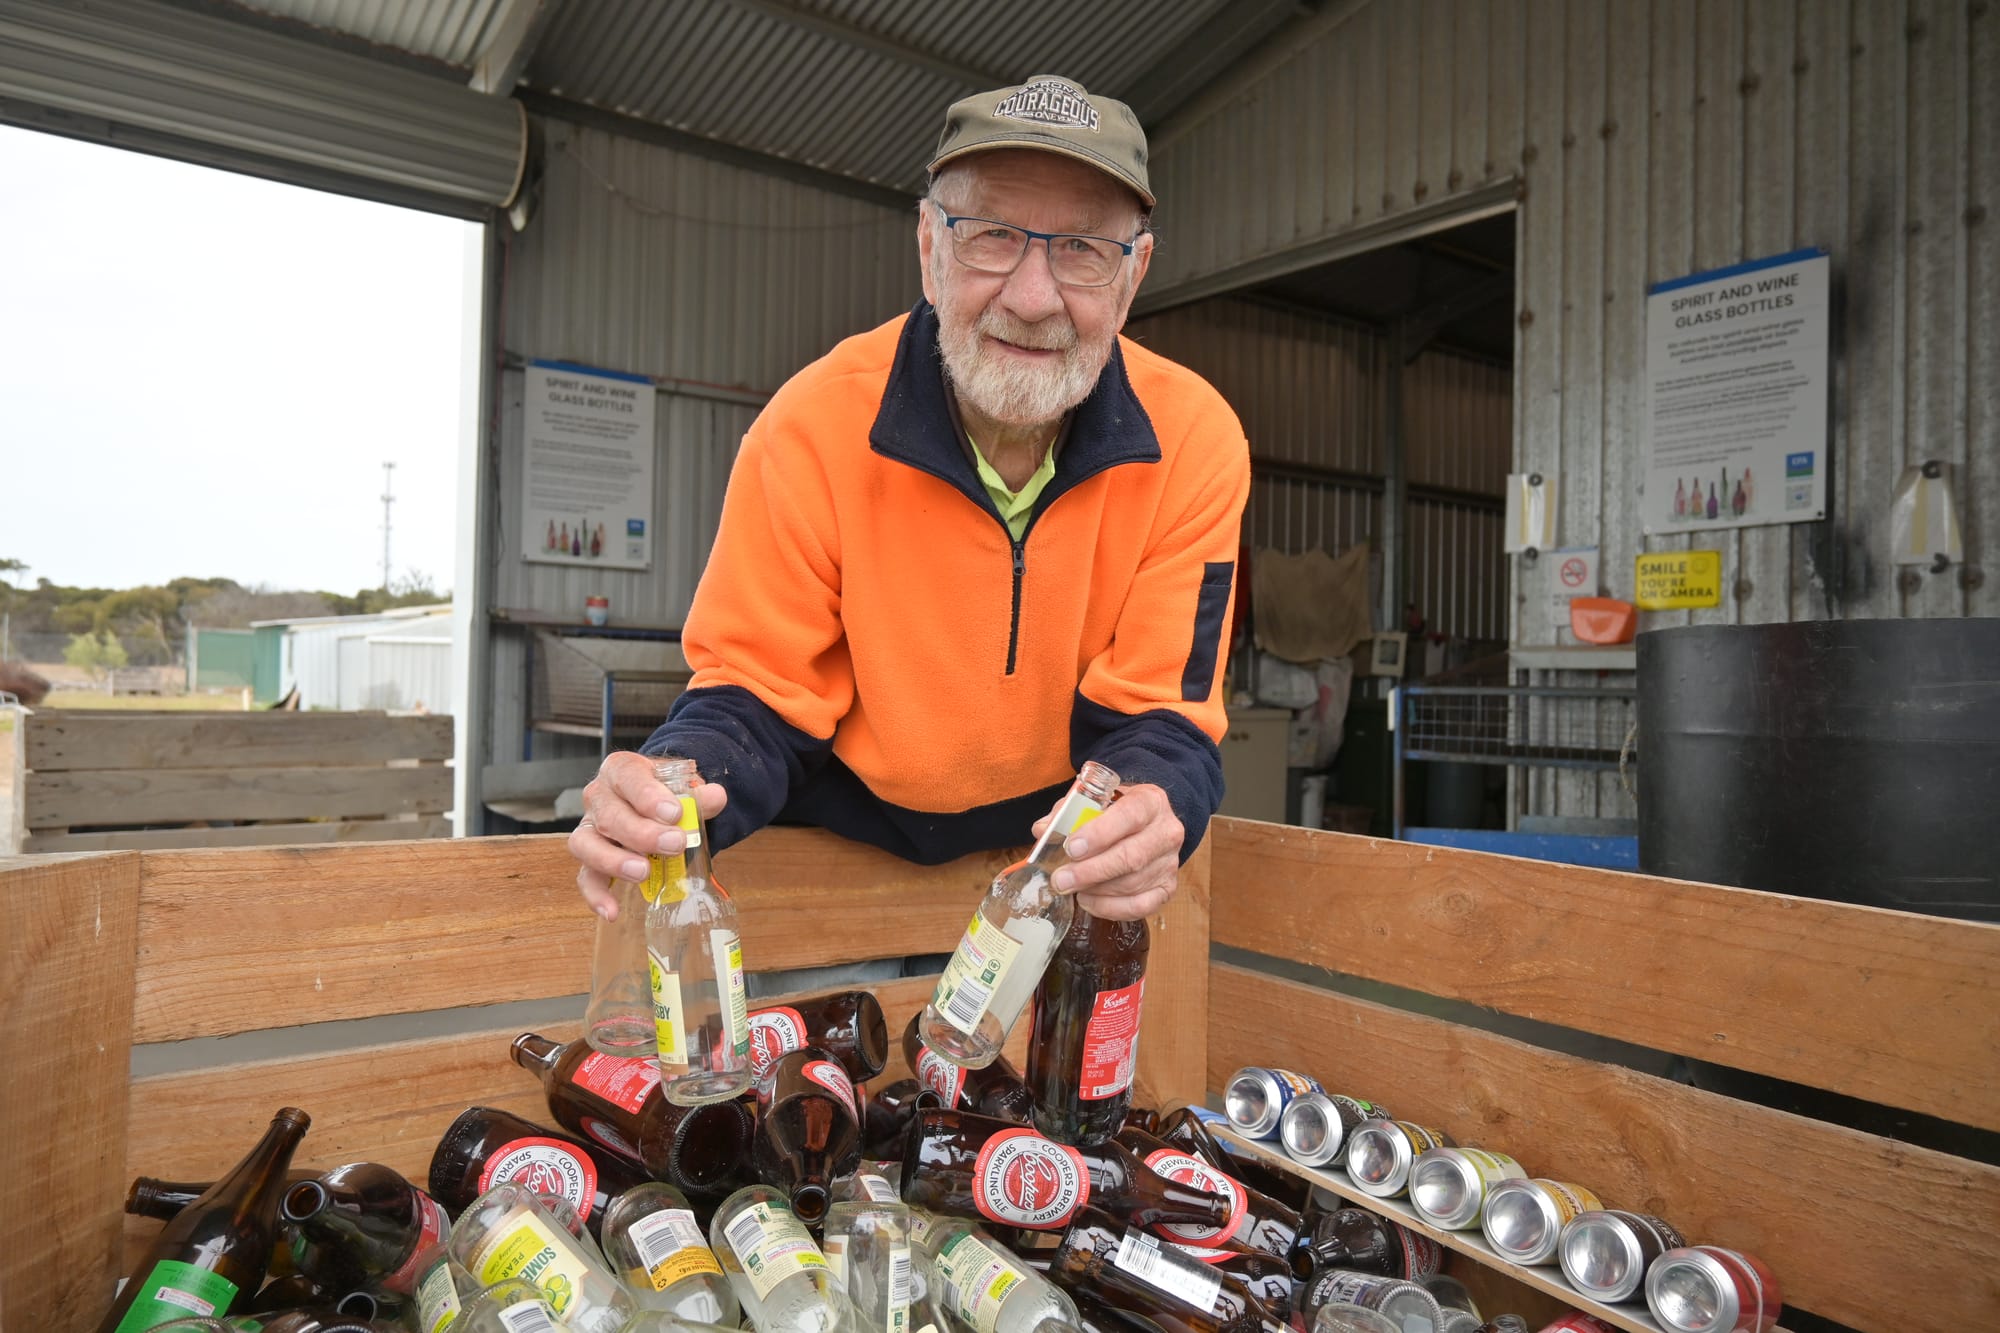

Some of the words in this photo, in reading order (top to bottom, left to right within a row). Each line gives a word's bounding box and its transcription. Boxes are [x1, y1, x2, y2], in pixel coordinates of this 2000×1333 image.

[994, 91, 1099, 131] COURAGEOUS
[1672, 291, 1715, 312] SPIRIT
[1719, 284, 1753, 301] AND
[1757, 273, 1799, 293] WINE
[1675, 308, 1722, 328] GLASS
[1727, 293, 1794, 318] BOTTLES
[546, 377, 579, 391] SPIRIT
[582, 383, 607, 396] AND
[609, 387, 636, 399] WINE
[587, 396, 633, 413] BOTTLES
[1640, 561, 1687, 577] SMILE
[1641, 577, 1686, 589] YOU'RE
[1641, 590, 1658, 599] ON
[1660, 586, 1714, 599] CAMERA
[558, 1157, 578, 1202] COOPERS
[989, 1143, 1017, 1196] SPARKLING
[1041, 1144, 1074, 1187] COOPERS
[1156, 1158, 1196, 1176] BREWERY
[1020, 1151, 1052, 1212] Coopers
[992, 1198, 1009, 1214] ALE
[1032, 1189, 1073, 1222] BREWERY
[501, 1251, 525, 1278] PEAR
